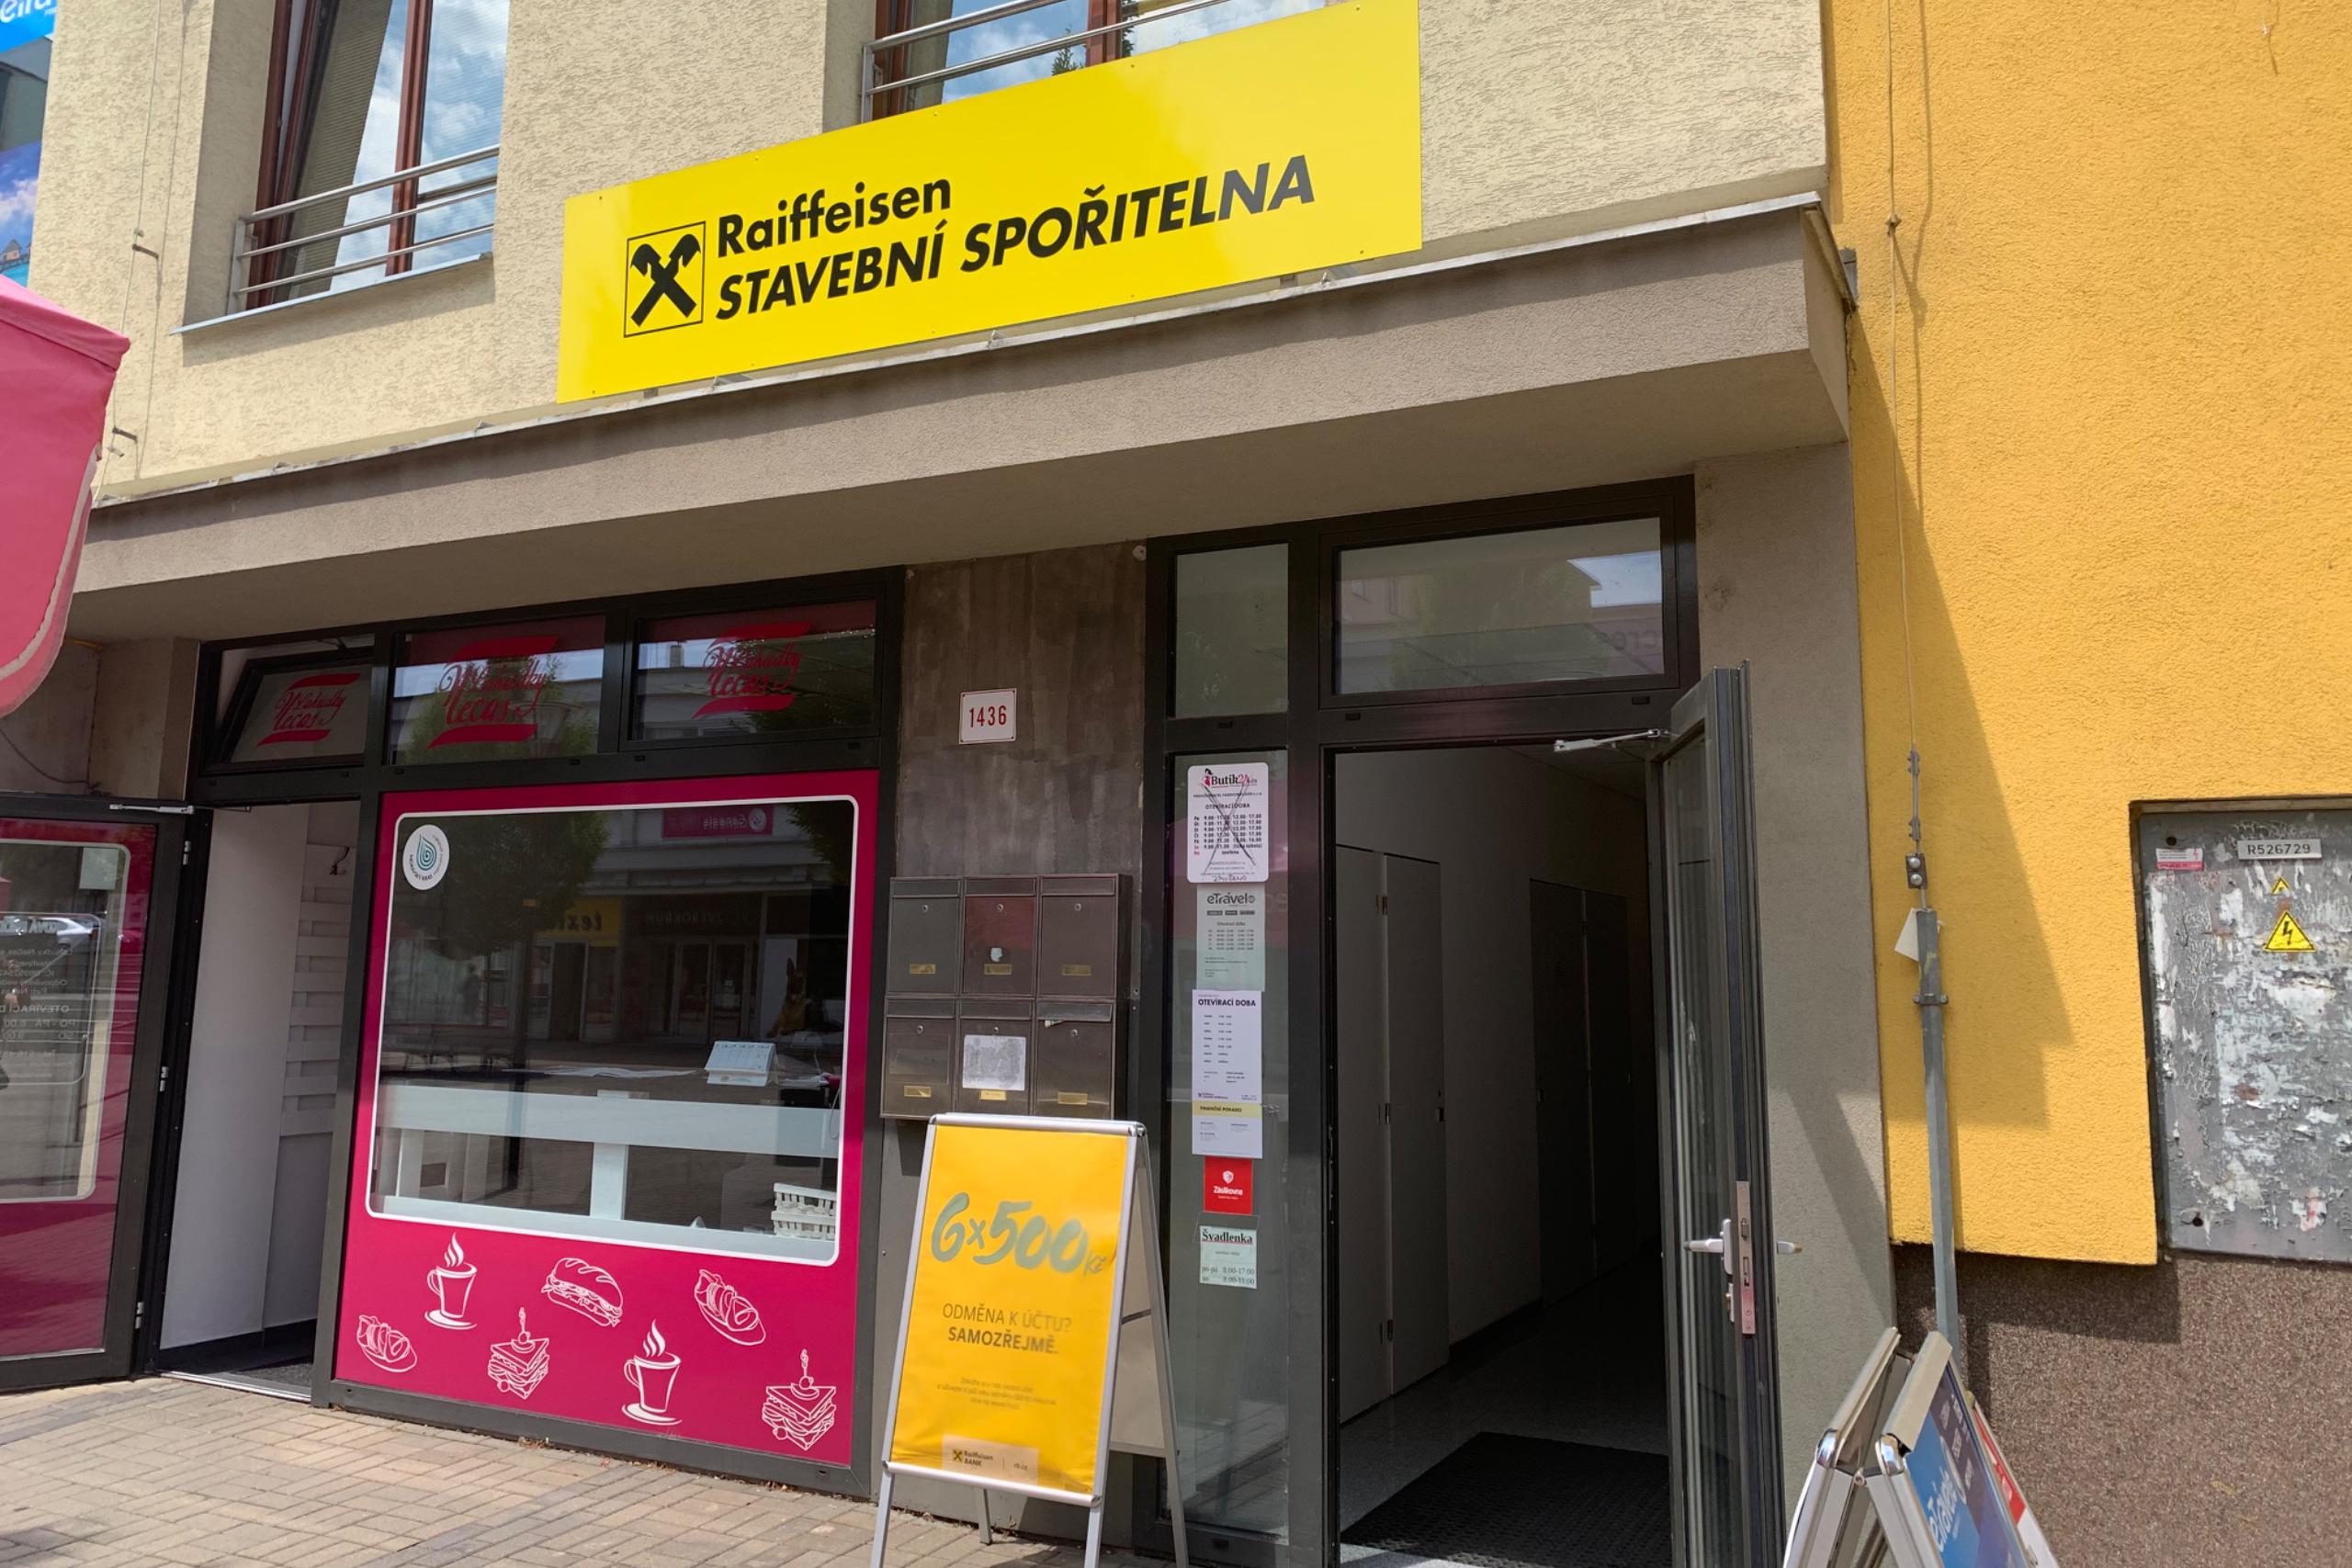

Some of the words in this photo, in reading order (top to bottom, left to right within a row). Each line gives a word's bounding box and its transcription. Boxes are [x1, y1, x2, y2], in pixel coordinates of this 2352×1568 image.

[718, 178, 952, 259] Raiffeisen
[715, 220, 946, 320] STAVEBNÍ
[960, 155, 1316, 273] SPOŘITELNA
[968, 705, 1008, 728] 1436
[2247, 843, 2312, 854] R526729
[1198, 998, 1234, 1007] OTEVÍRACÍ
[1236, 999, 1256, 1008] DOBA
[931, 1191, 1089, 1274] 6x500
[1202, 1228, 1254, 1246] Švadlenka
[943, 1302, 1004, 1325] ODMĚNA
[1010, 1311, 1018, 1326] K
[1023, 1308, 1072, 1333] ÚČTU?
